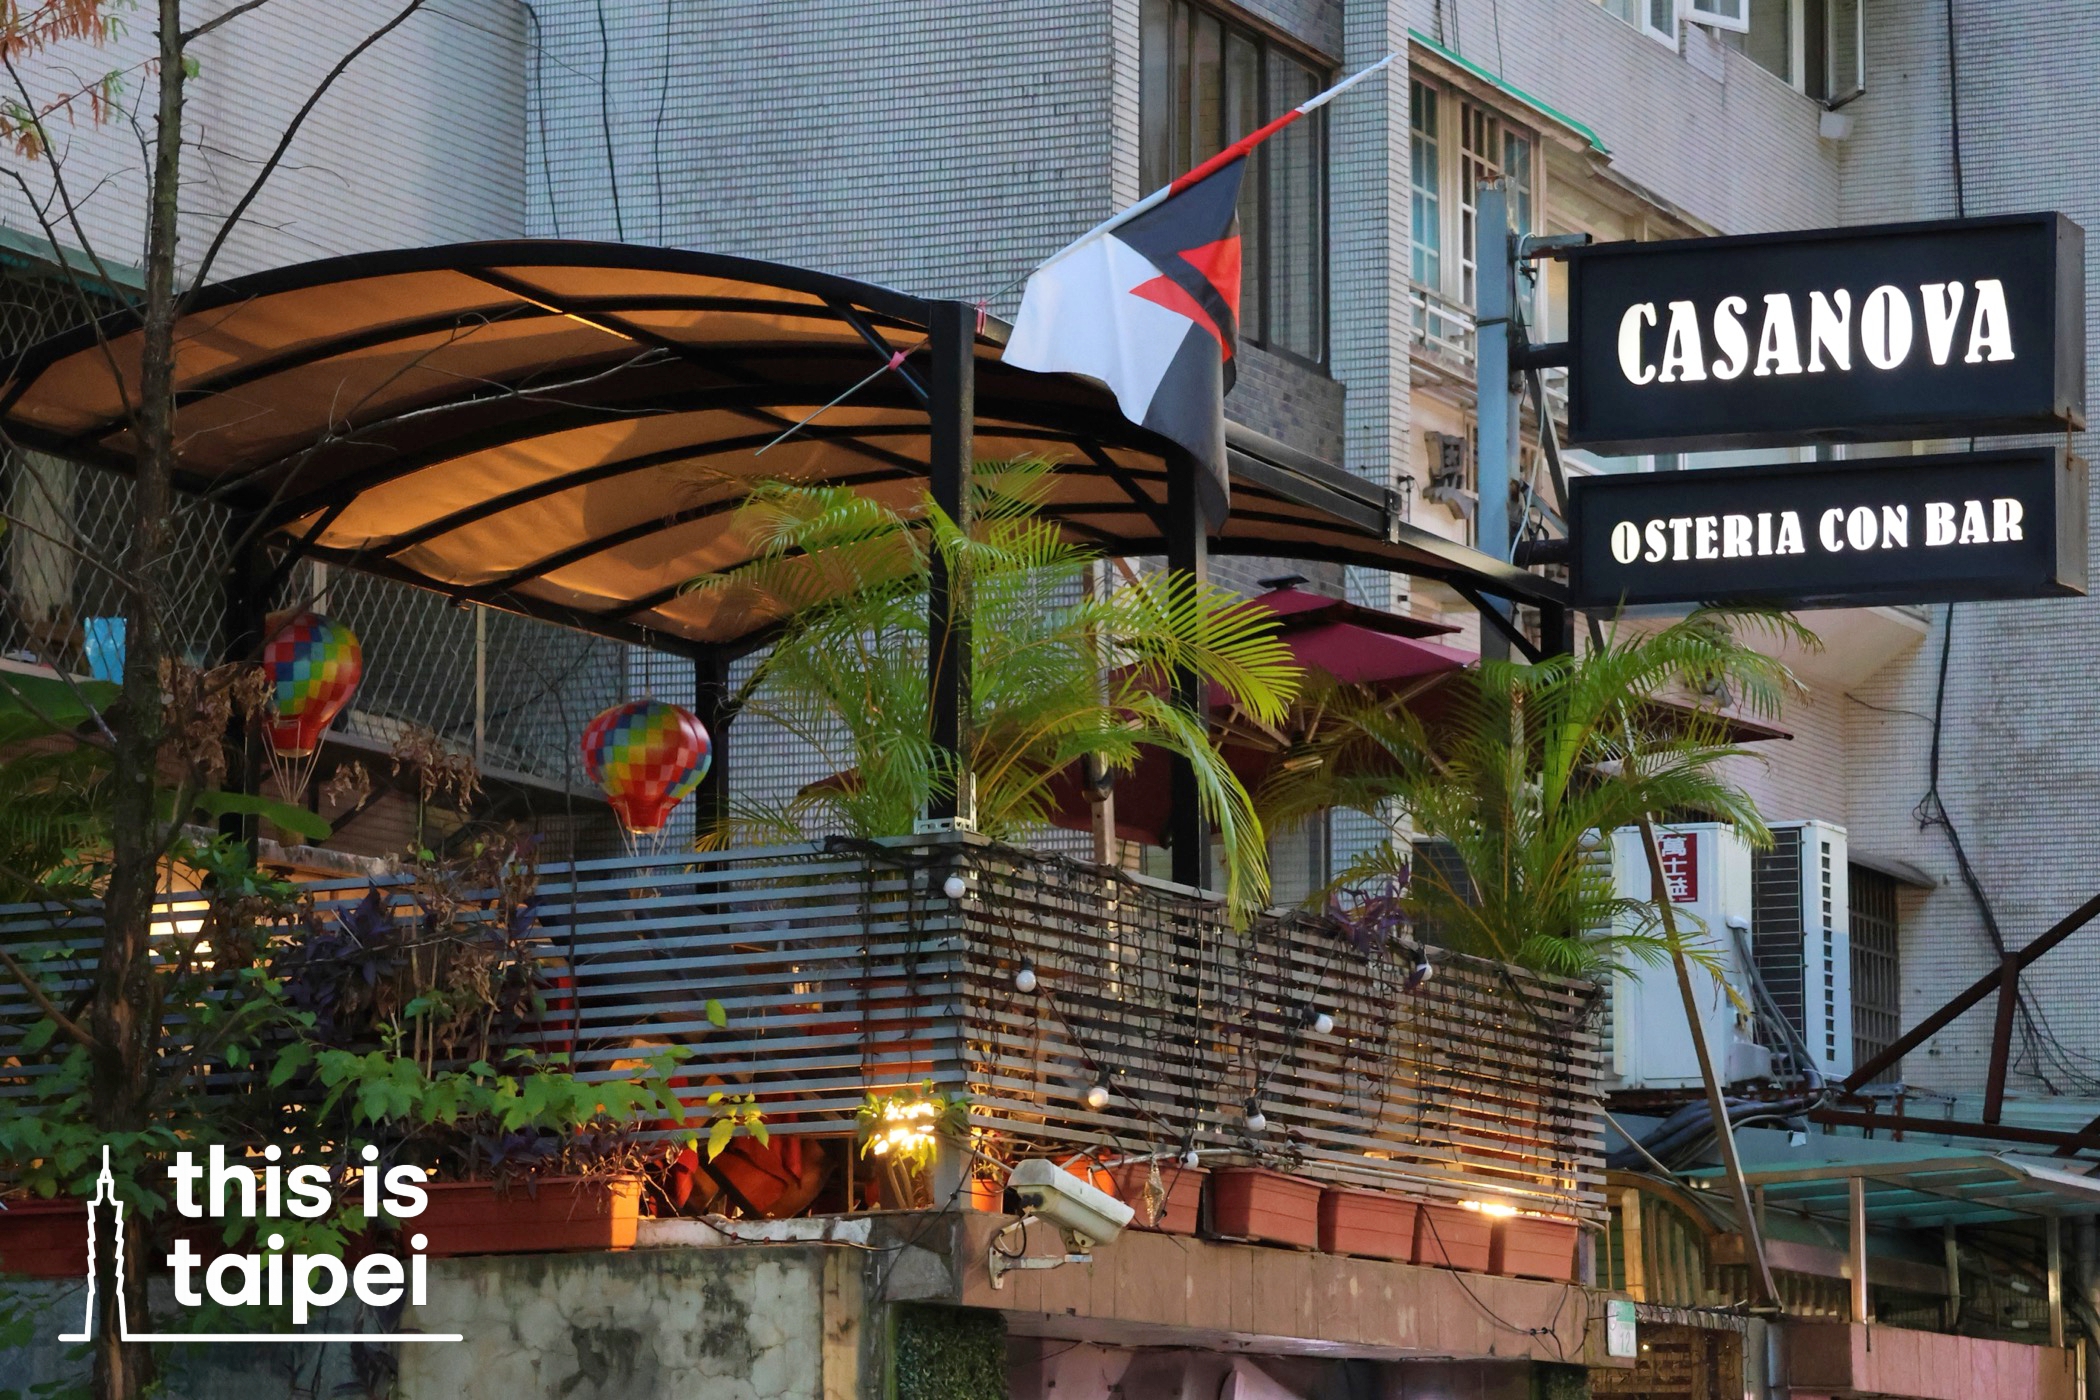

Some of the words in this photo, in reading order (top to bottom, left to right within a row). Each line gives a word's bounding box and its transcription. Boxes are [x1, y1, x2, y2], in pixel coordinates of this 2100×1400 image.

[1618, 279, 2015, 385] CASANOVA
[1611, 511, 1805, 564] OSTERIA
[1820, 505, 1908, 552] CON
[1925, 499, 2023, 546] BAR
